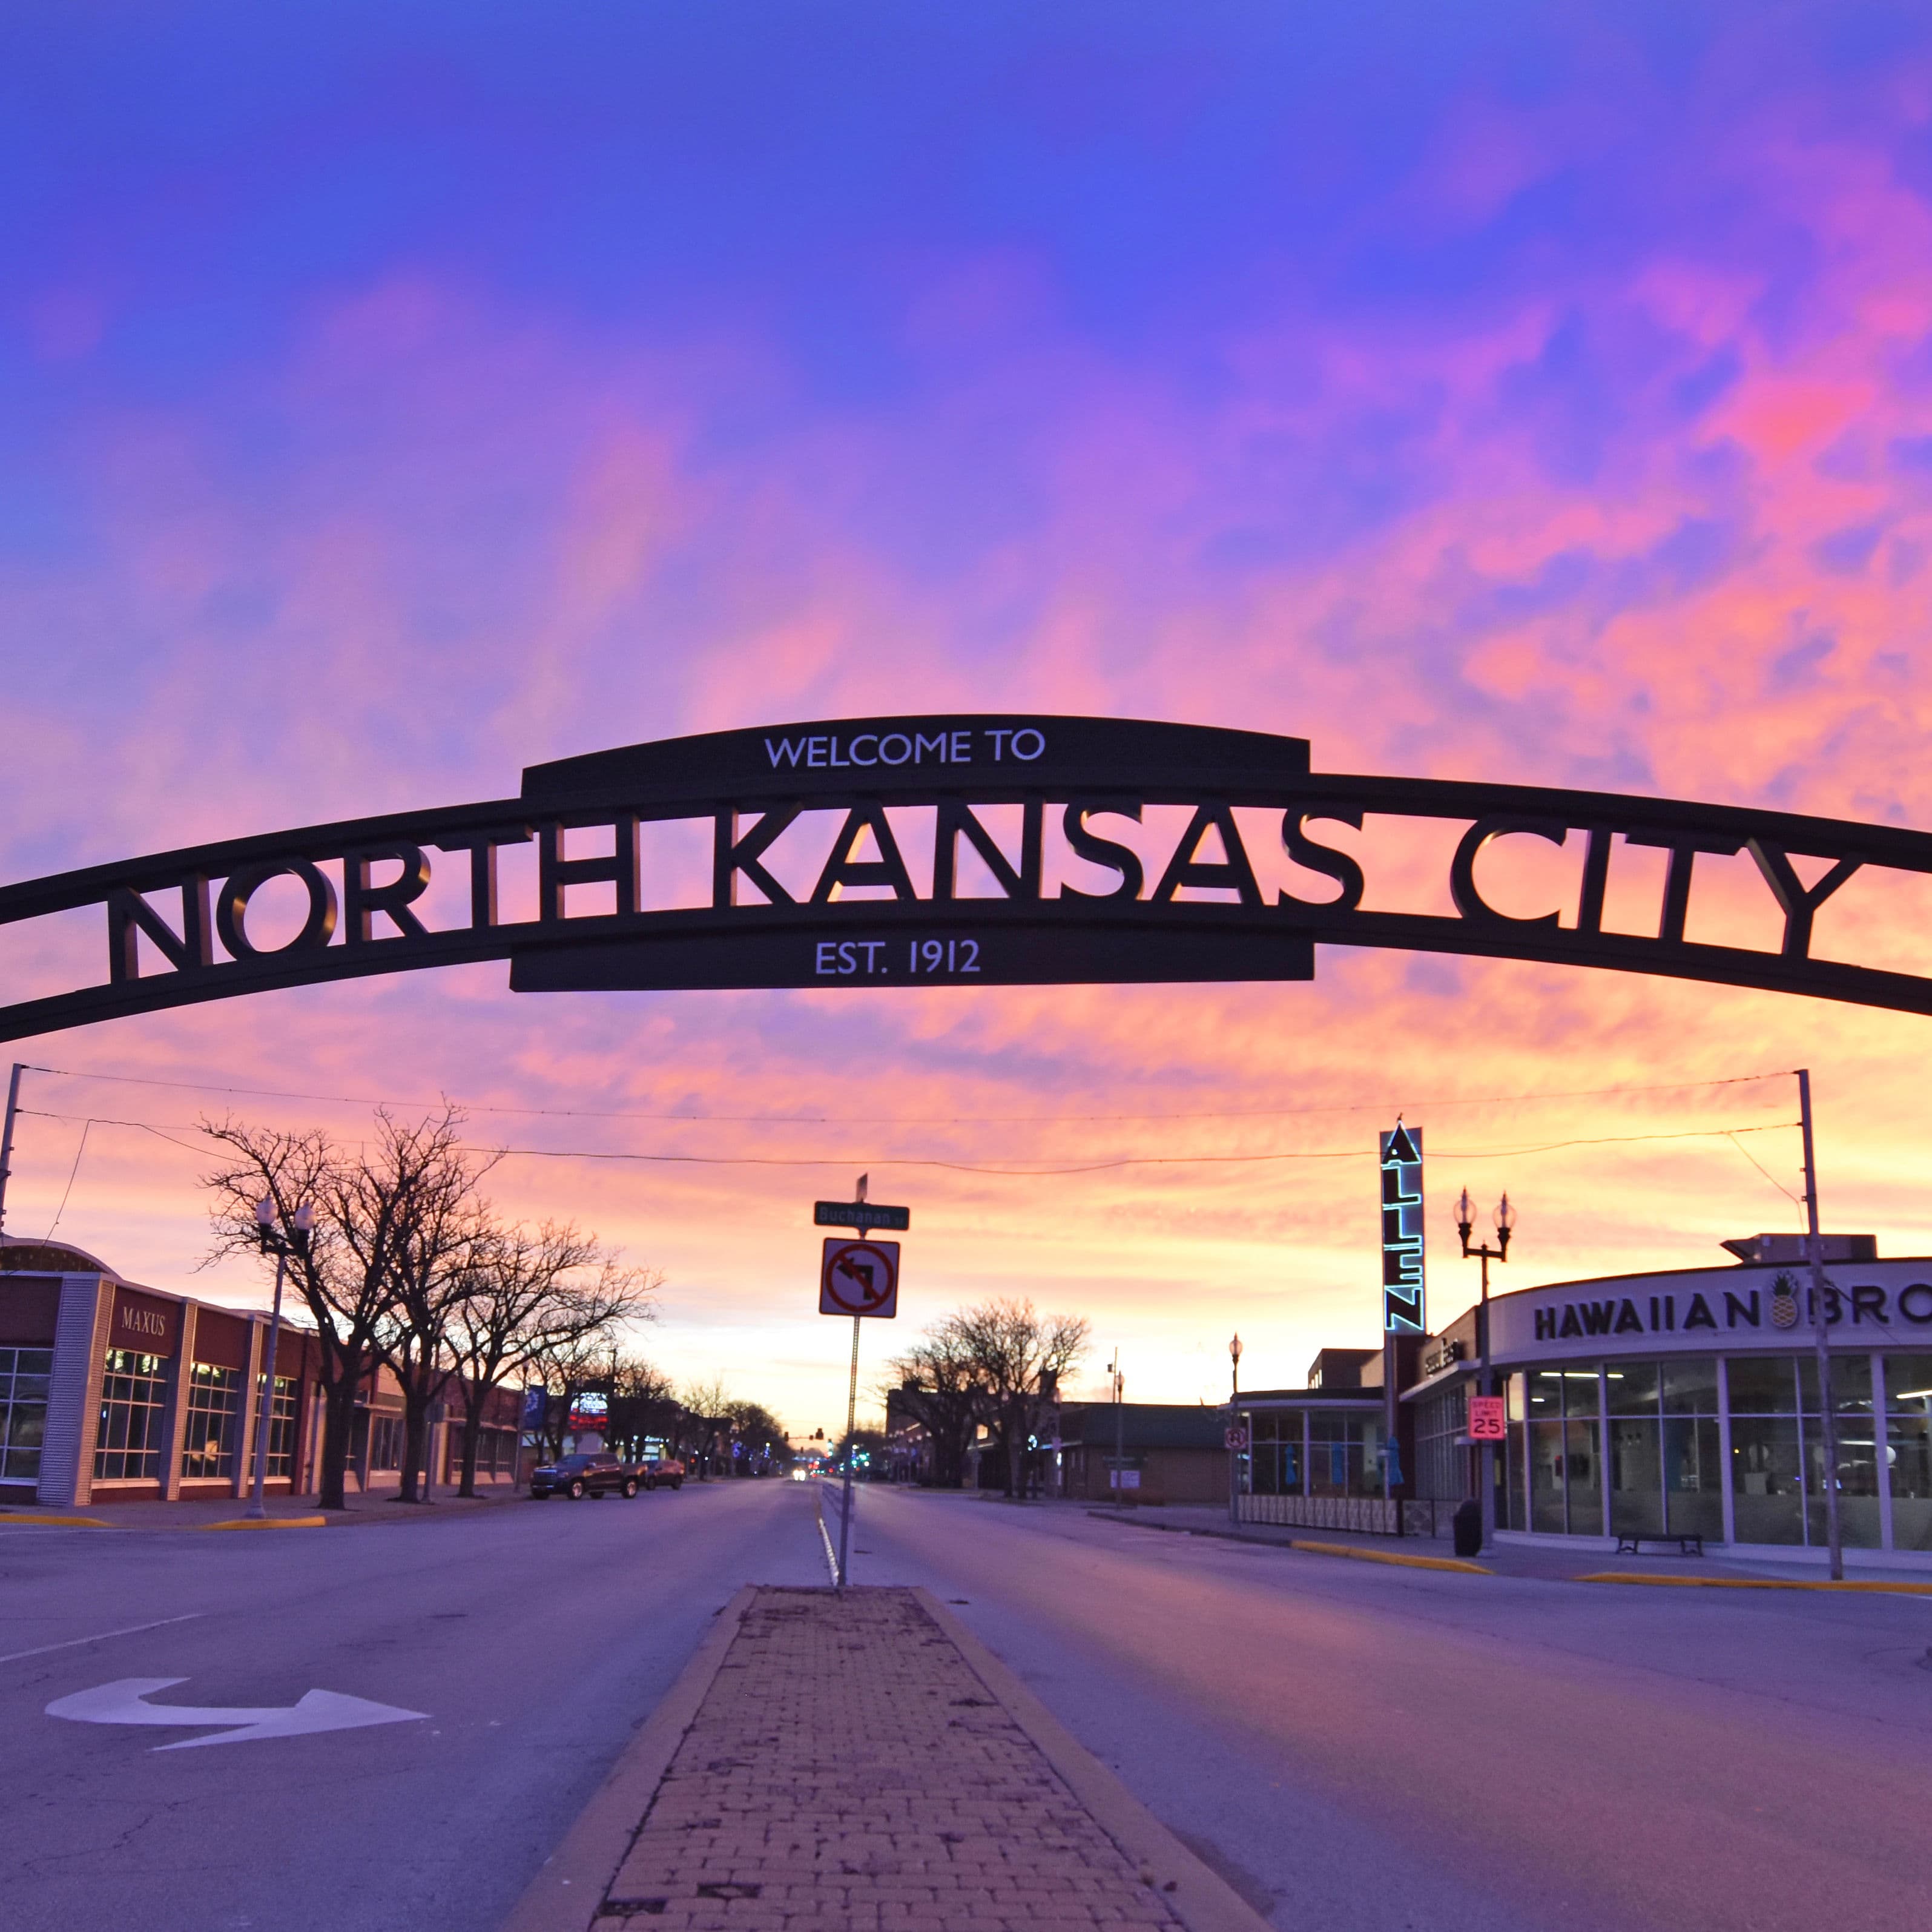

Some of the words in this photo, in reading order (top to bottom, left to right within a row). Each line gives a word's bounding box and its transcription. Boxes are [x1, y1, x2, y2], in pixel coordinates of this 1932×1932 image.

[764, 731, 971, 768] WELCOME
[984, 728, 1046, 761] TO
[108, 814, 641, 982] NORTH
[714, 803, 1364, 907] KANSAS
[1449, 815, 1865, 959] CITY
[816, 941, 888, 974] EST.
[910, 940, 981, 973] 1912
[819, 1206, 891, 1225] Buchanan
[1381, 1119, 1423, 1331] ALLEN
[122, 1306, 165, 1337] MAXUS
[1535, 1290, 1760, 1340] HAWAIIAN
[1474, 1419, 1500, 1434] 25
